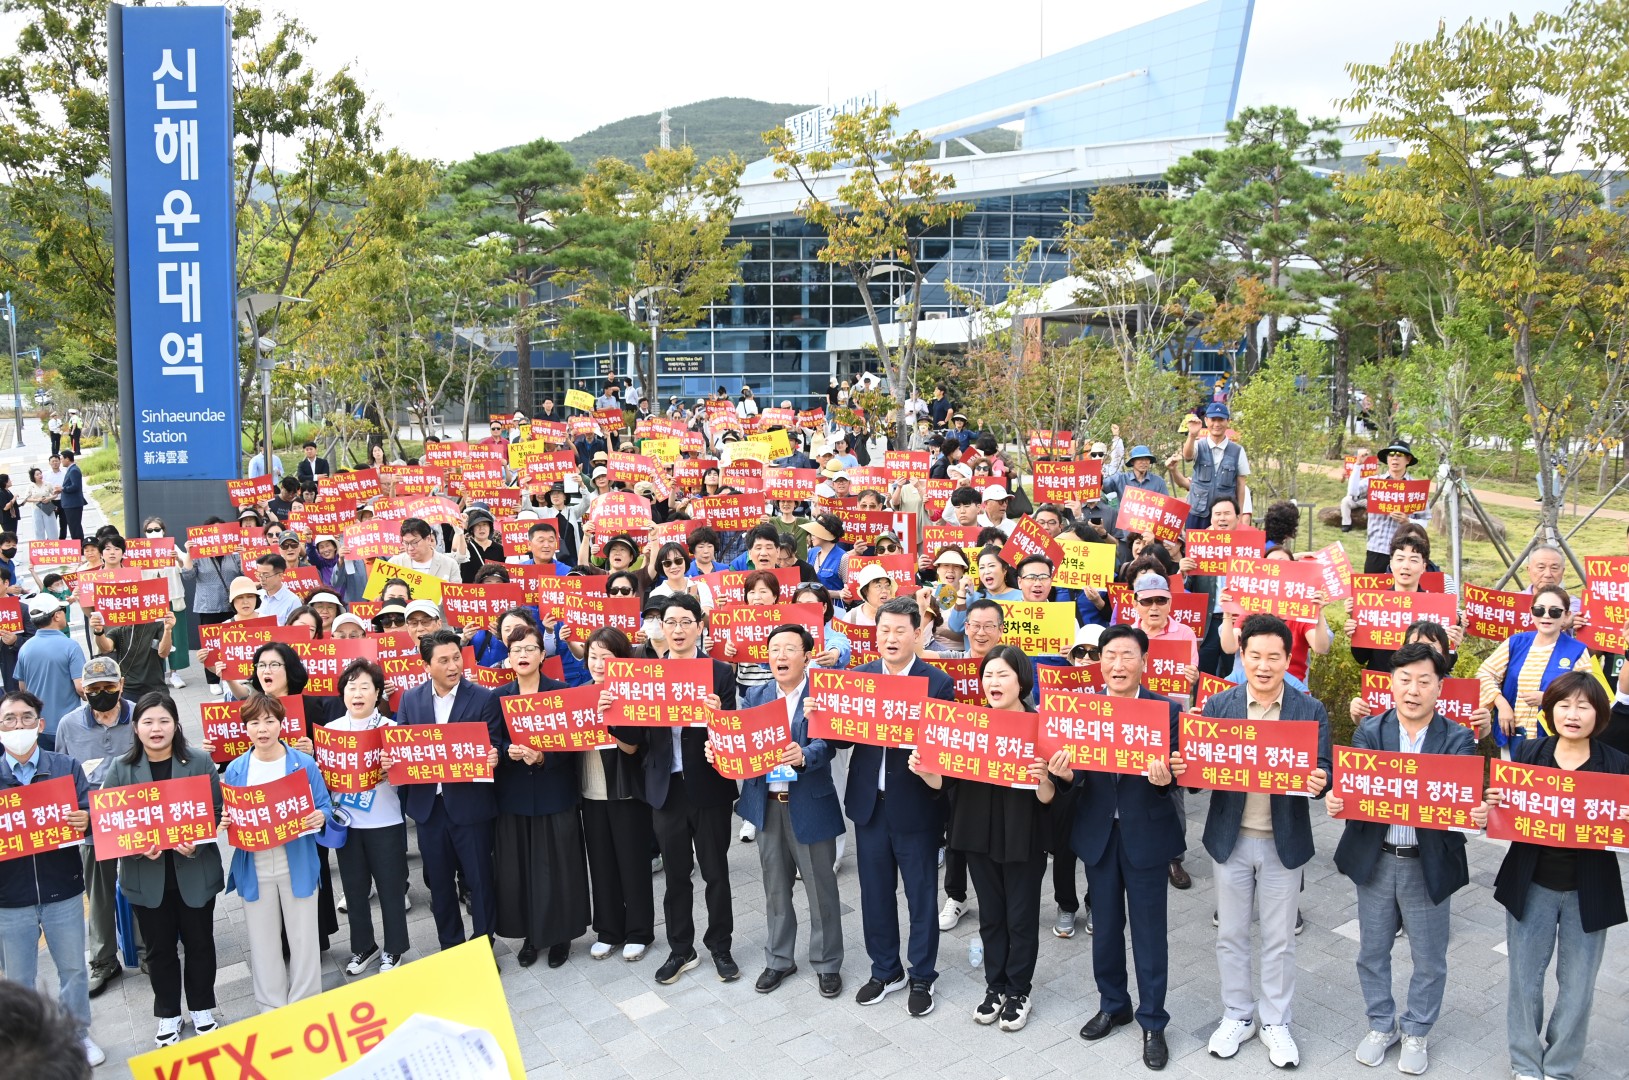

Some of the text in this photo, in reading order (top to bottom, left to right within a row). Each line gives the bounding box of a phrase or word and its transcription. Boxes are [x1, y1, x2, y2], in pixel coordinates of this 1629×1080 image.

[152, 48, 204, 393] 신해운대역
[141, 409, 226, 424] Sinhaeundae
[142, 429, 187, 443] Station
[143, 450, 189, 465] 新海雲臺
[428, 451, 451, 459] 신해운대역
[526, 454, 553, 465] KTX-이음
[609, 452, 635, 462] KTX-이음
[885, 452, 910, 460] KTX-이음
[529, 461, 573, 472] 신해운대역 정차로
[609, 460, 635, 471] 신해운대역
[886, 461, 927, 470] 신해운대역 정차로
[1036, 464, 1075, 474] KTX-이음
[535, 472, 553, 481] 해운대
[766, 470, 793, 478] KTX-이음
[1037, 475, 1097, 488] 신해운대역 정차로
[228, 480, 253, 488] KTX-이음
[231, 485, 271, 497] 신해운대역 정차로
[764, 476, 813, 491] 신해운대역 정차로
[1370, 480, 1405, 490] KTX-이음
[705, 498, 738, 506] KTX-이음
[772, 490, 790, 498] 해운대
[1047, 488, 1098, 502] 해운대 발전을!
[1126, 489, 1165, 507] KTX-이음
[1371, 491, 1425, 502] 신해운대역 정차로
[305, 504, 335, 512] KTX-이음
[629, 504, 651, 517] 정차로
[708, 506, 762, 518] 신해운대역 정차로
[1122, 501, 1181, 528] 신해운대역 정차로
[1379, 503, 1424, 514] 해운대 발전을!
[308, 510, 355, 523] 신해운대역 정차로
[599, 517, 623, 528] 해운대
[717, 520, 738, 528] 해운대
[189, 527, 219, 536] KTX-이음
[316, 524, 335, 533] 해운대
[346, 522, 378, 535] KTX-이음
[190, 534, 239, 546] 신해운대역 정차로
[347, 532, 400, 548] 신해운대역 정차로
[1188, 532, 1232, 543] KTX-이음
[32, 548, 60, 556] 신해운대역
[199, 546, 219, 555] 해운대
[357, 545, 379, 556] 해운대
[1189, 545, 1232, 560] 신해운대역
[60, 556, 80, 565] 발전을!
[152, 558, 174, 567] 발전을!
[1200, 561, 1228, 573] 해운대
[1230, 559, 1280, 577] KTX-이음
[378, 564, 421, 584] KTX-이음
[96, 585, 138, 595] KTX-이음
[444, 585, 486, 597] KTX-이음
[1230, 576, 1316, 600] 신해운대역 정차로
[1466, 584, 1517, 607] KTX-이음
[98, 594, 166, 610] 신해운대역 정차로
[447, 599, 487, 613] 신해운대역
[566, 595, 604, 611] KTX-이음
[1240, 595, 1317, 618] 해운대 발전을!
[1356, 592, 1412, 609] KTX-이음
[109, 608, 166, 623] 해운대 발전을!
[567, 610, 635, 628] 신해운대역 정차로
[733, 609, 781, 622] KTX-이음
[1357, 610, 1412, 627] 신해운대역
[1466, 602, 1514, 624] 신해운대역
[223, 631, 272, 643] KTX-이음
[833, 620, 869, 638] KTX-이음
[1476, 622, 1508, 638] 해운대
[608, 662, 664, 678] KTX-이음
[1153, 659, 1186, 675] 정차로
[814, 672, 876, 694] KTX-이음
[1039, 668, 1091, 684] KTX-이음
[606, 682, 709, 703] 신해운대역 정차로
[1148, 677, 1186, 692] 발전을!
[505, 696, 563, 713] KTX-이음
[813, 693, 922, 720] 신해운대역 정차로
[1044, 694, 1114, 717] KTX-이음
[623, 705, 660, 721] 해운대
[925, 702, 990, 728] KTX-이음
[512, 712, 568, 732] 신해운대역
[831, 717, 869, 739] 해운대
[1183, 718, 1257, 740] KTX-이음
[315, 728, 358, 748] KTX-이음
[385, 729, 443, 742] KTX-이음
[529, 729, 612, 748] 해운대 발전을!
[752, 726, 786, 749] 정차로
[1046, 717, 1162, 746] 신해운대역 정차로
[925, 726, 1034, 759] 신해운대역 정차로
[314, 747, 357, 772] 신해운대역
[388, 743, 486, 764] 신해운대역 정차로
[1062, 744, 1107, 766] 해운대
[1184, 741, 1309, 768] 신해운대역 정차로
[407, 762, 492, 779] 해운대 발전을!
[938, 751, 980, 776] 해운대
[1339, 751, 1418, 774] KTX-이음
[324, 770, 352, 789] 해운대
[1202, 767, 1249, 787] 해운대
[1496, 764, 1576, 792] KTX-이음
[222, 787, 265, 804] KTX-이음
[1340, 773, 1473, 803] 신해운대역 정차로
[94, 787, 160, 810] KTX-이음
[1498, 788, 1575, 818] 신해운대역
[275, 796, 312, 819] 정차로
[1359, 799, 1476, 827] 해운대 발전을!
[98, 801, 207, 832] 신해운대역 정차로
[117, 822, 212, 850] 해운대 발전을!
[1515, 816, 1565, 842] 해운대
[238, 829, 270, 846] 해운대
